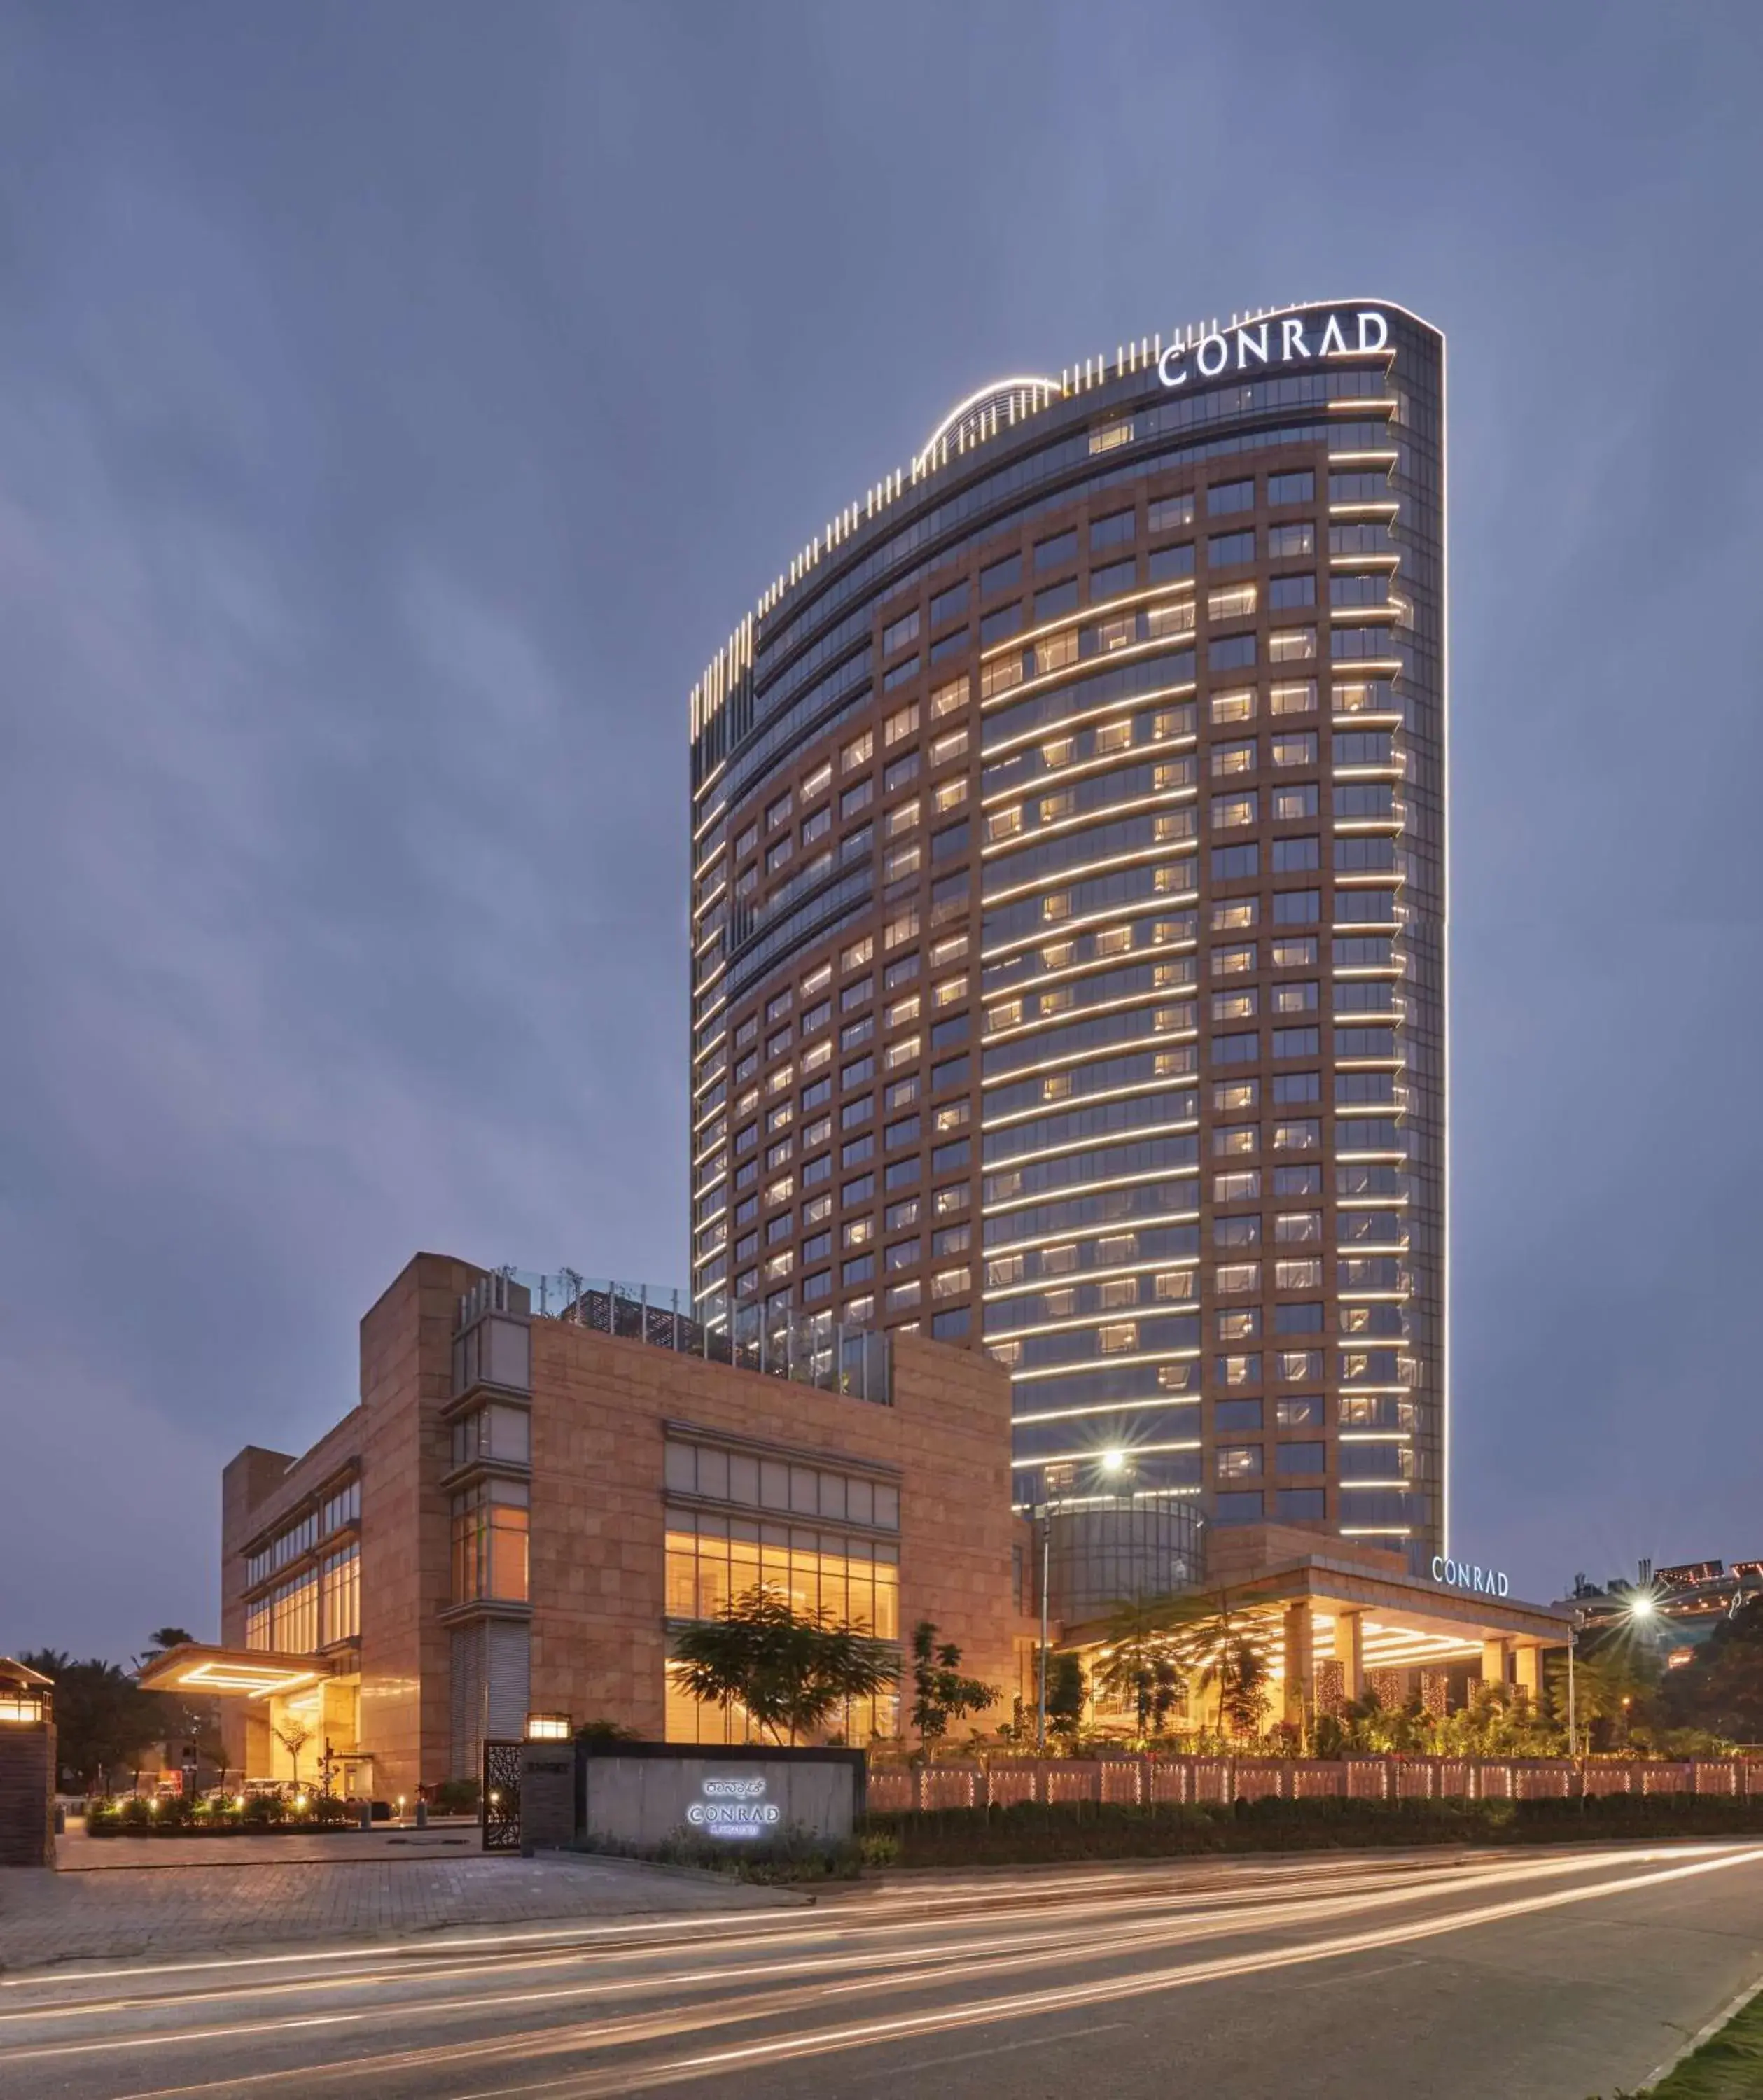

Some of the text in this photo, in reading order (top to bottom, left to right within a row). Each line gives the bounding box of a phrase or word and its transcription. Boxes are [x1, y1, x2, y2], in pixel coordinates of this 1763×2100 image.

[1158, 312, 1388, 387] CONRAD
[1432, 1555, 1509, 1597] CONRAD
[690, 1806, 779, 1822] CONRAD
